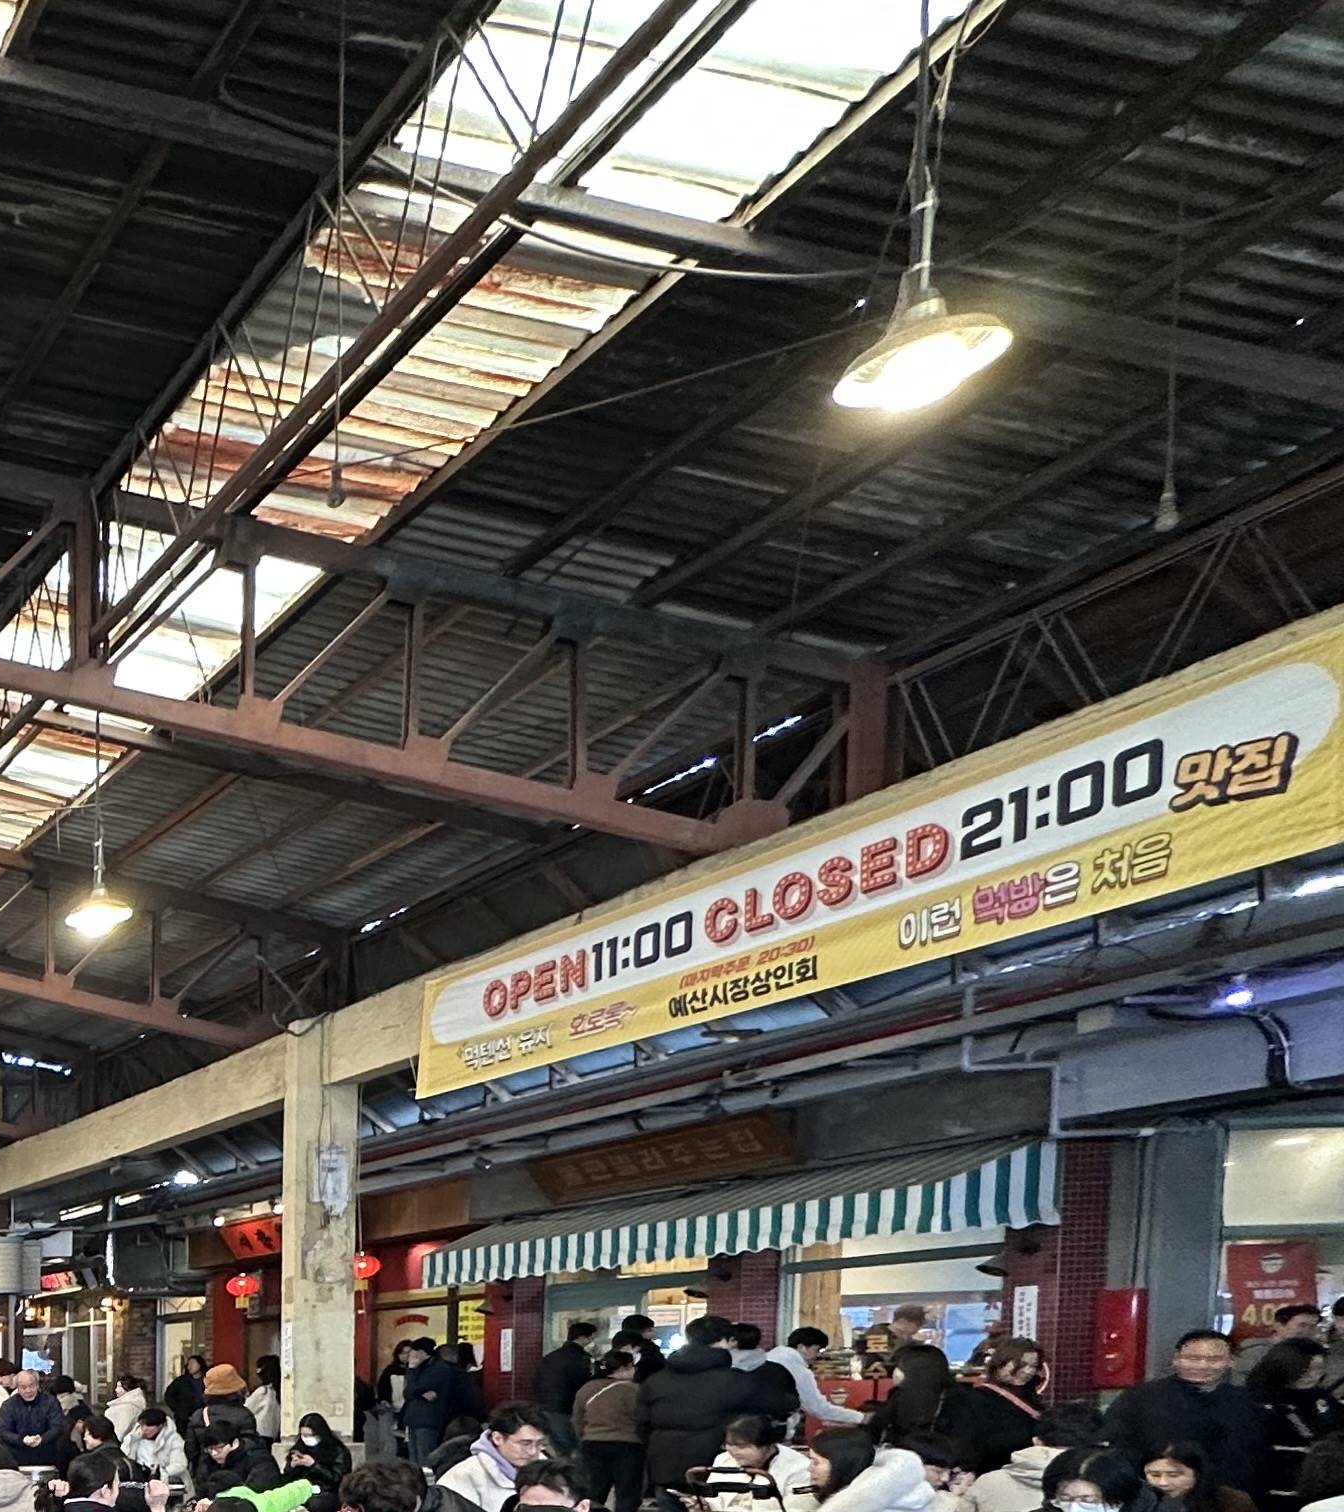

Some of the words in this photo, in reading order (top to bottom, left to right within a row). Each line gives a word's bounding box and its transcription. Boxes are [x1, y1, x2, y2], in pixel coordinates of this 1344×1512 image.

[1169, 733, 1299, 813] 맛집
[482, 950, 587, 1018] OPEN
[592, 910, 694, 982] 11:00
[703, 821, 951, 944] CLOSED
[960, 738, 1164, 862] 21:00
[898, 899, 963, 950] 이런
[970, 861, 1081, 927] 먹방은
[1091, 831, 1174, 897] 처음
[668, 953, 819, 1019] 예산시장상인회
[463, 1038, 512, 1071] 먹텐션
[517, 1023, 553, 1058] 유지
